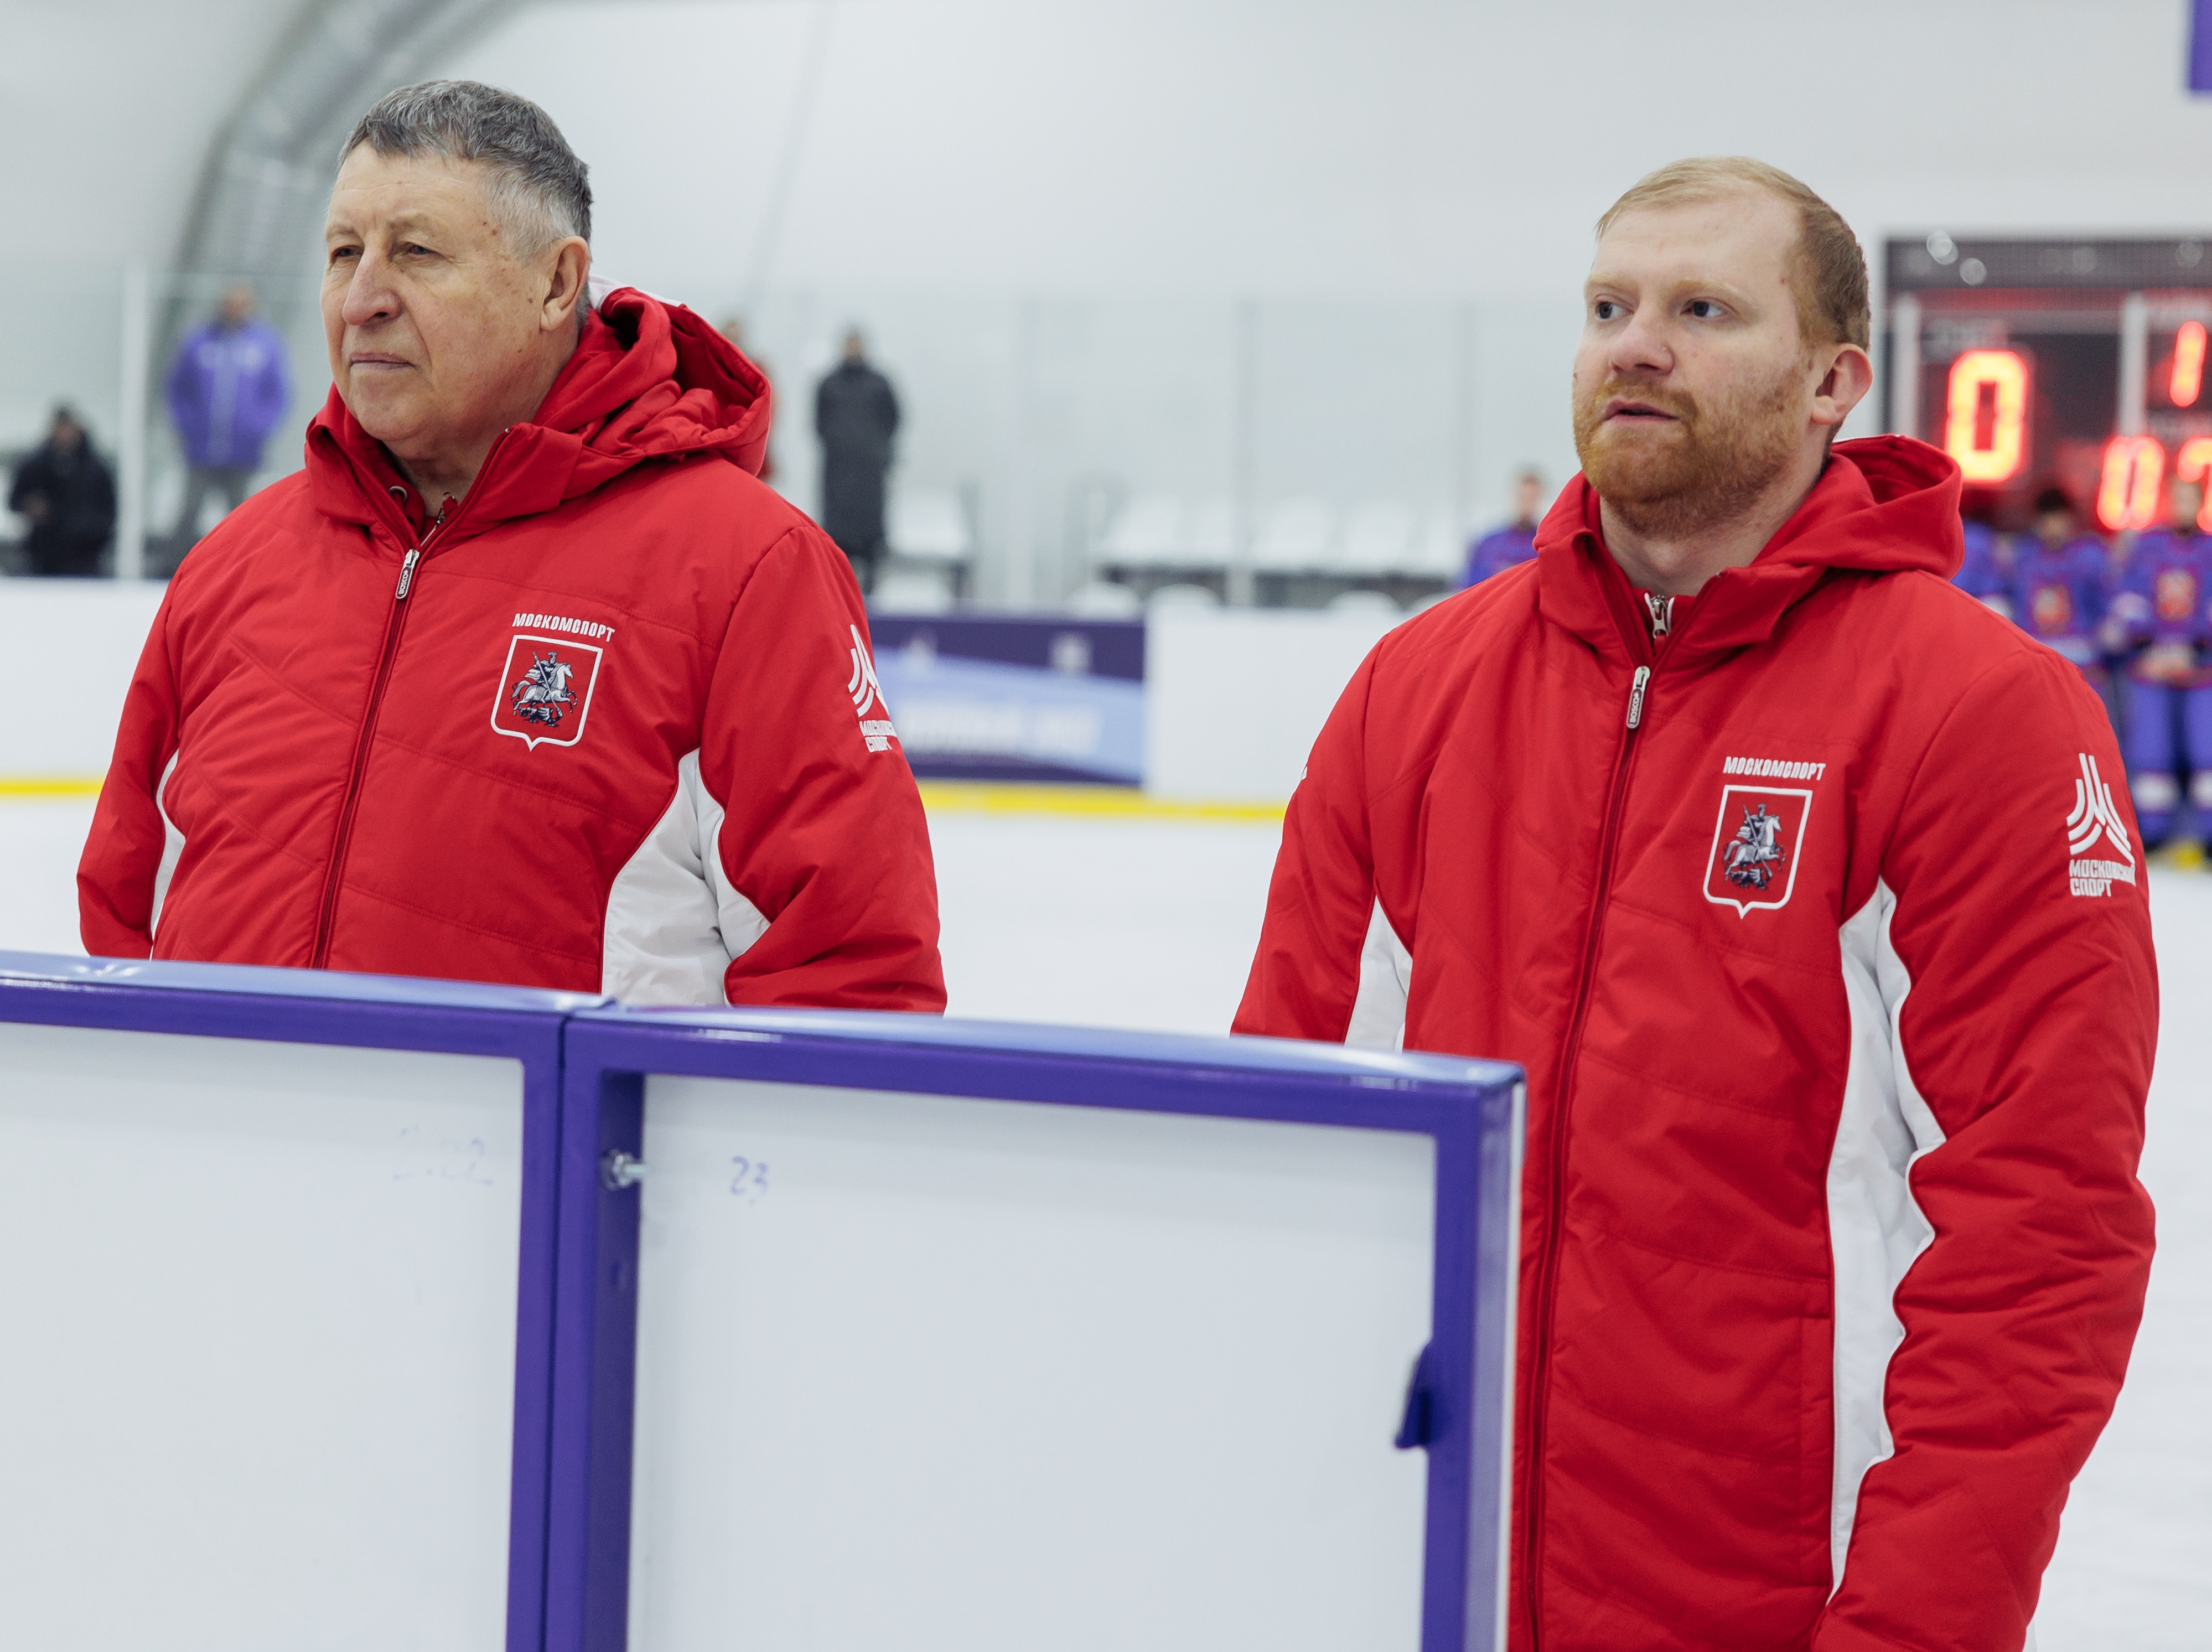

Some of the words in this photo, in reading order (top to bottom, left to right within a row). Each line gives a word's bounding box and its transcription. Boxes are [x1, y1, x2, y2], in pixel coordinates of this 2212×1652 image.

[1945, 351, 2028, 483] 0
[512, 613, 615, 642] МОСКОМСПОРТ
[1723, 756, 1826, 781] МОСКОМСПОРТ
[2070, 878, 2112, 897] СПОРТ
[729, 1156, 769, 1206] 23
